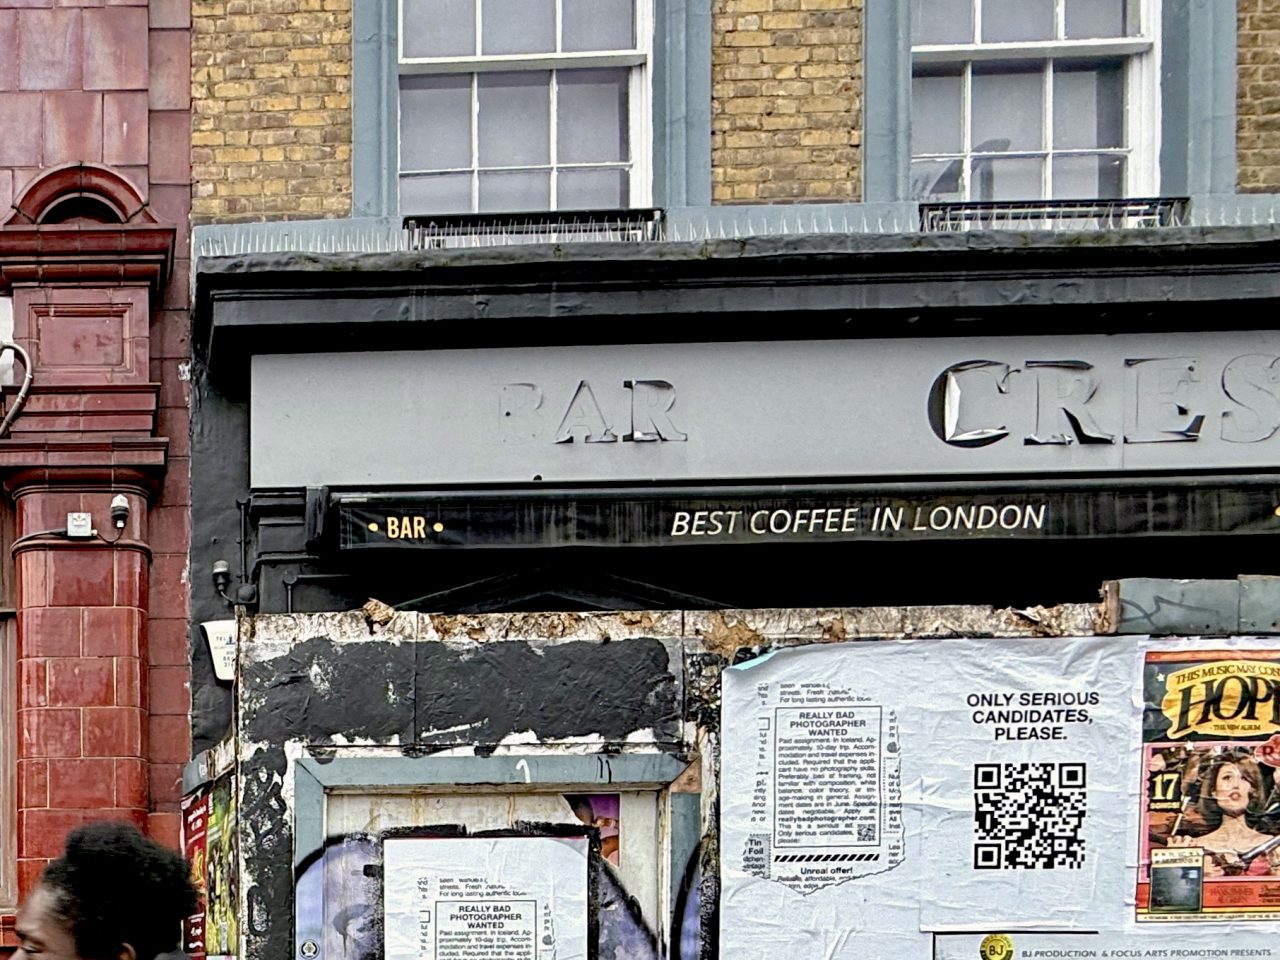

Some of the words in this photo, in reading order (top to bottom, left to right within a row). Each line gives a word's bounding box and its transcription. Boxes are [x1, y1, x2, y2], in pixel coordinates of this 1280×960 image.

[387, 516, 426, 538] BAR
[671, 511, 742, 536] BEST
[751, 508, 858, 534] COFFEE
[872, 507, 903, 532] IN
[913, 504, 1046, 532] LONDON
[1176, 669, 1200, 684] THIS
[1202, 665, 1235, 678] MUSIC
[967, 693, 1014, 707] ONLY
[1019, 692, 1099, 706] SERIOUS
[790, 720, 866, 728] PHOTOGRAPHER
[973, 709, 1093, 725] CANDIDATES,
[995, 727, 1068, 741] PLEASE.
[1152, 773, 1180, 800] 17
[1022, 950, 1033, 958] BJ
[1034, 950, 1097, 958] PRODUCTION
[1111, 949, 1142, 957] FOCUS
[1144, 949, 1168, 957] ARTS
[1170, 949, 1229, 957] PROMOTION
[1230, 949, 1272, 957] PRESENTS
